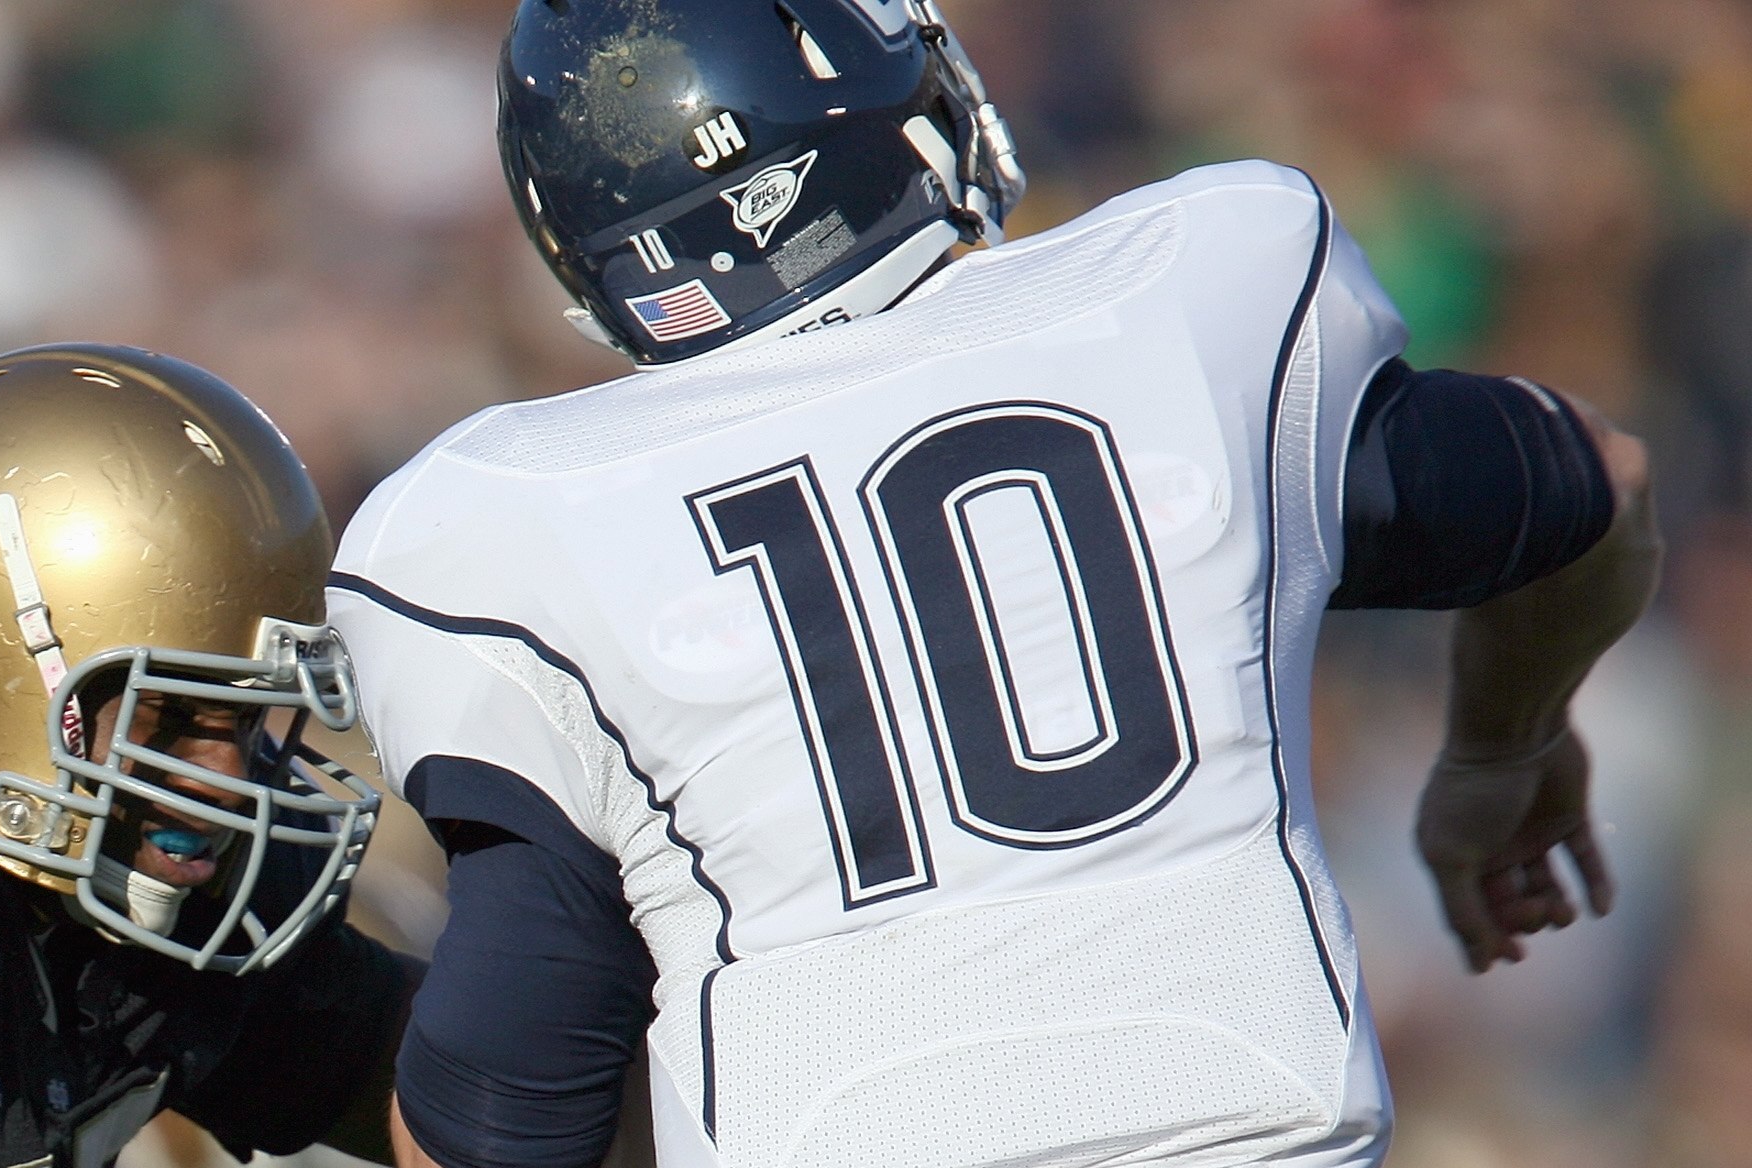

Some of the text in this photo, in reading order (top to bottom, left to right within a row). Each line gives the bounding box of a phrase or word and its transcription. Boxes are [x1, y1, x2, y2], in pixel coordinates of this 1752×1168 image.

[693, 111, 747, 168] JH
[751, 182, 778, 206] BIG
[751, 187, 789, 215] EAST
[629, 228, 675, 273] 10
[682, 399, 1200, 912] 10
